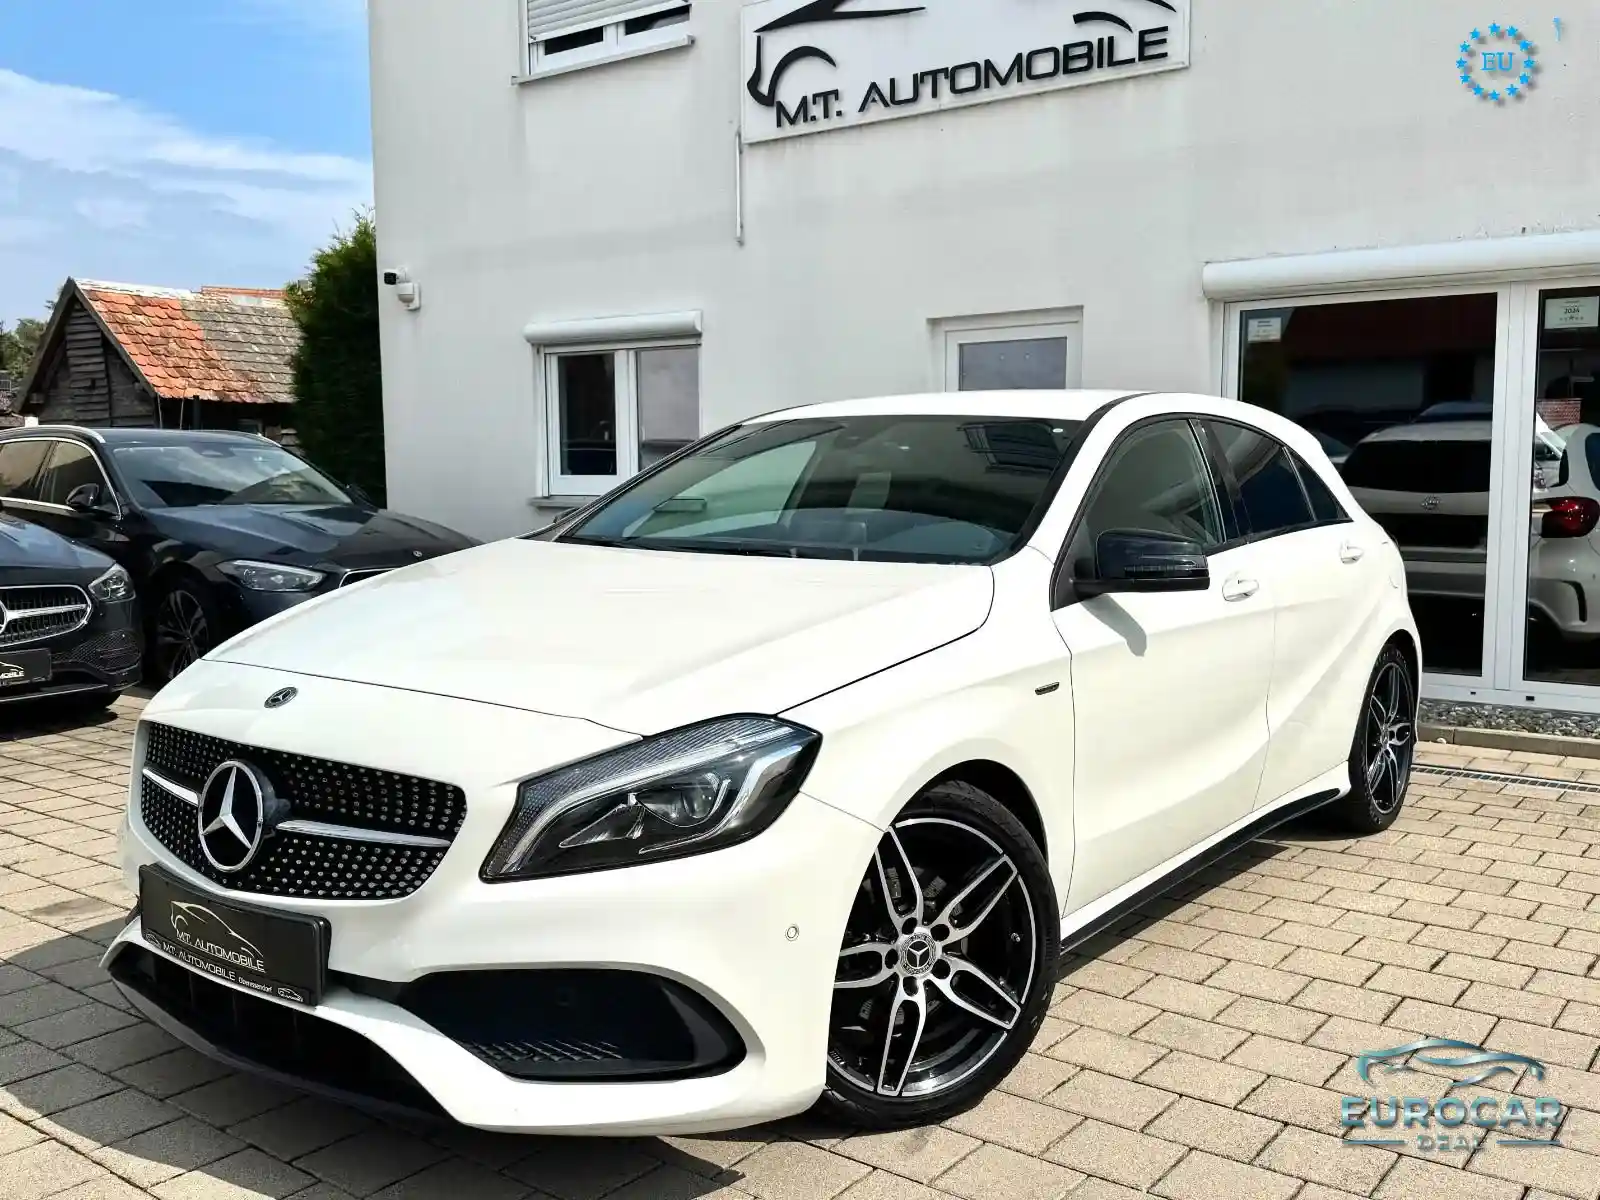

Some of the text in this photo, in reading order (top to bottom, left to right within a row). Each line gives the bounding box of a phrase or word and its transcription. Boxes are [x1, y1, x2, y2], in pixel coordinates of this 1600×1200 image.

[775, 26, 1169, 128] M.T. AUTOMOBILE
[178, 950, 236, 981] AUTOMOBILE
[194, 938, 265, 971] AUTOMOBILE
